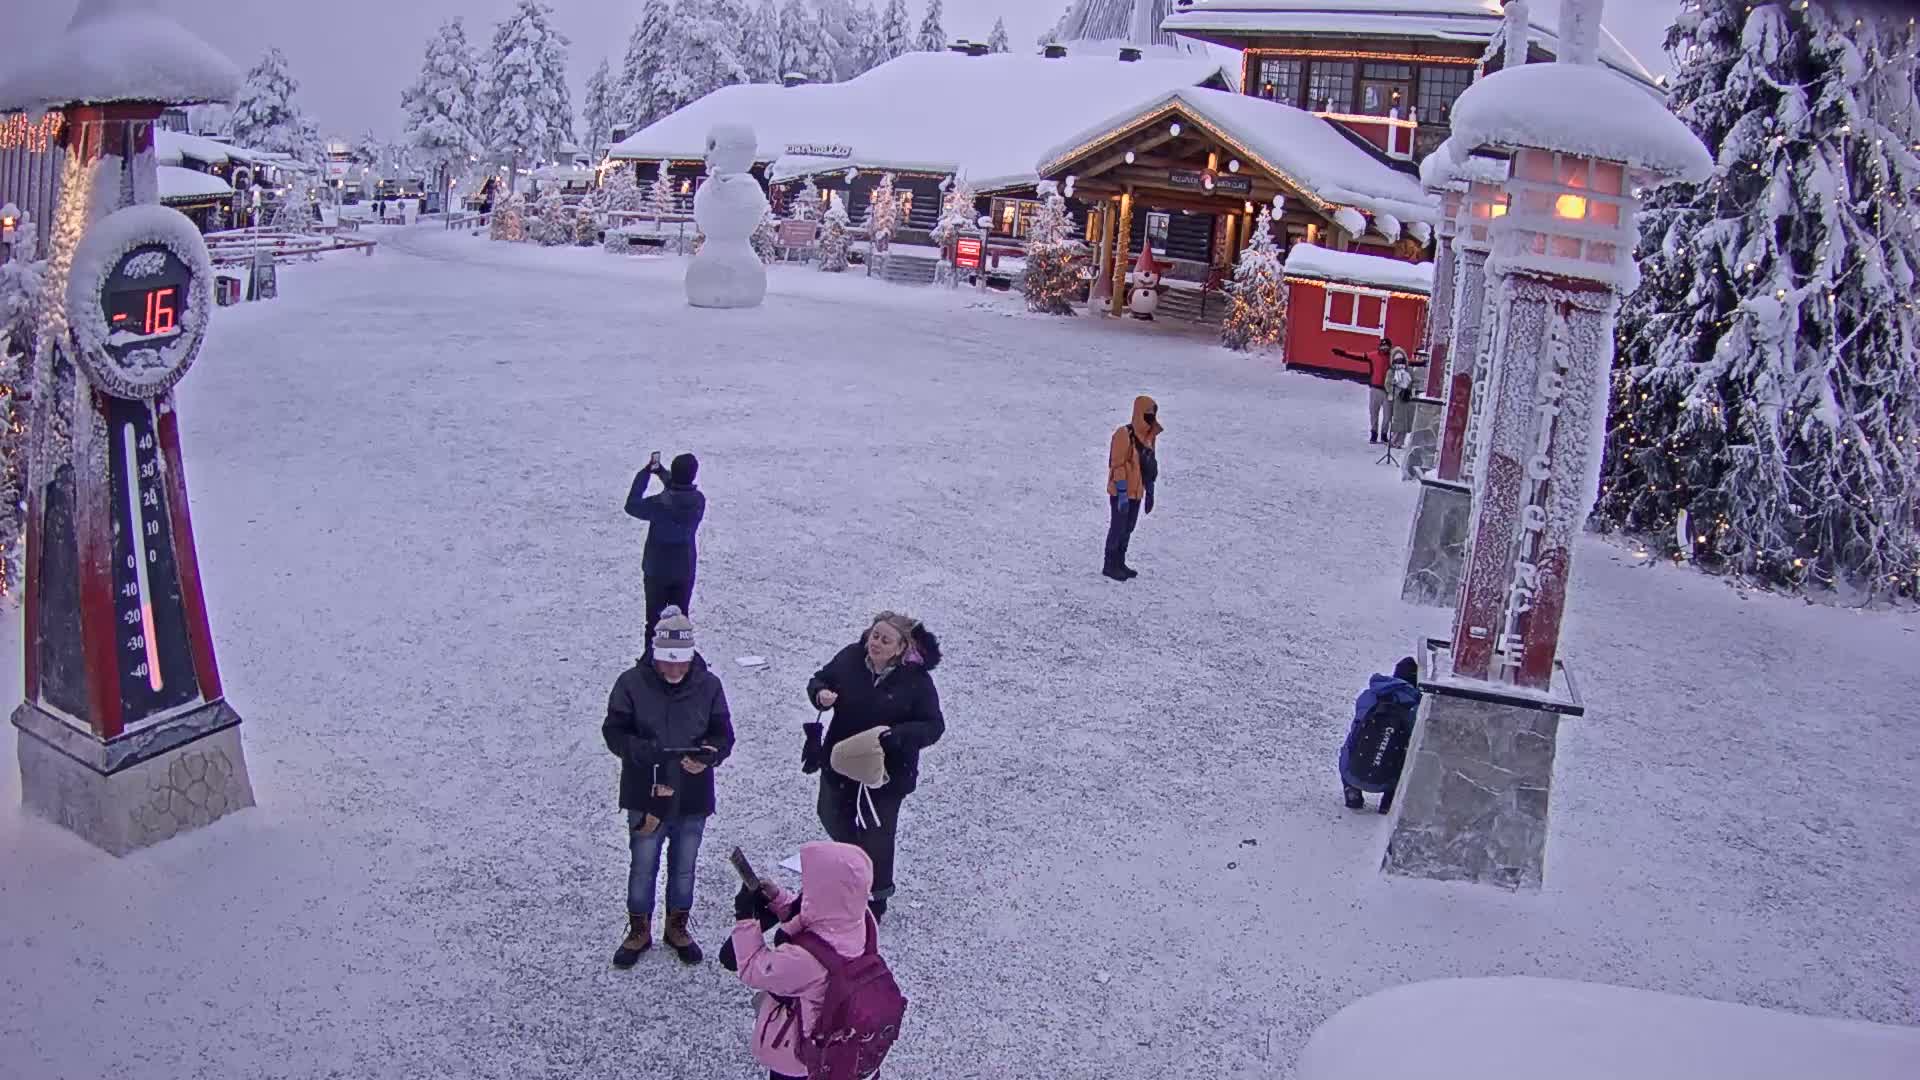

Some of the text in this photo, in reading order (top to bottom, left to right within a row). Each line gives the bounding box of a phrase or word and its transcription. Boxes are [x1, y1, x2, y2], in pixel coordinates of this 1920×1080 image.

[139, 433, 153, 449] 40
[141, 463, 154, 478] 30
[143, 488, 158, 507] 20
[1501, 314, 1570, 667] ARCTIC CIRCLE
[146, 520, 159, 536] 10
[127, 554, 135, 569] 0
[149, 549, 157, 563] 0
[121, 582, 138, 597] -10
[124, 608, 141, 625] -20
[127, 635, 144, 651] -30
[130, 662, 148, 678] -40
